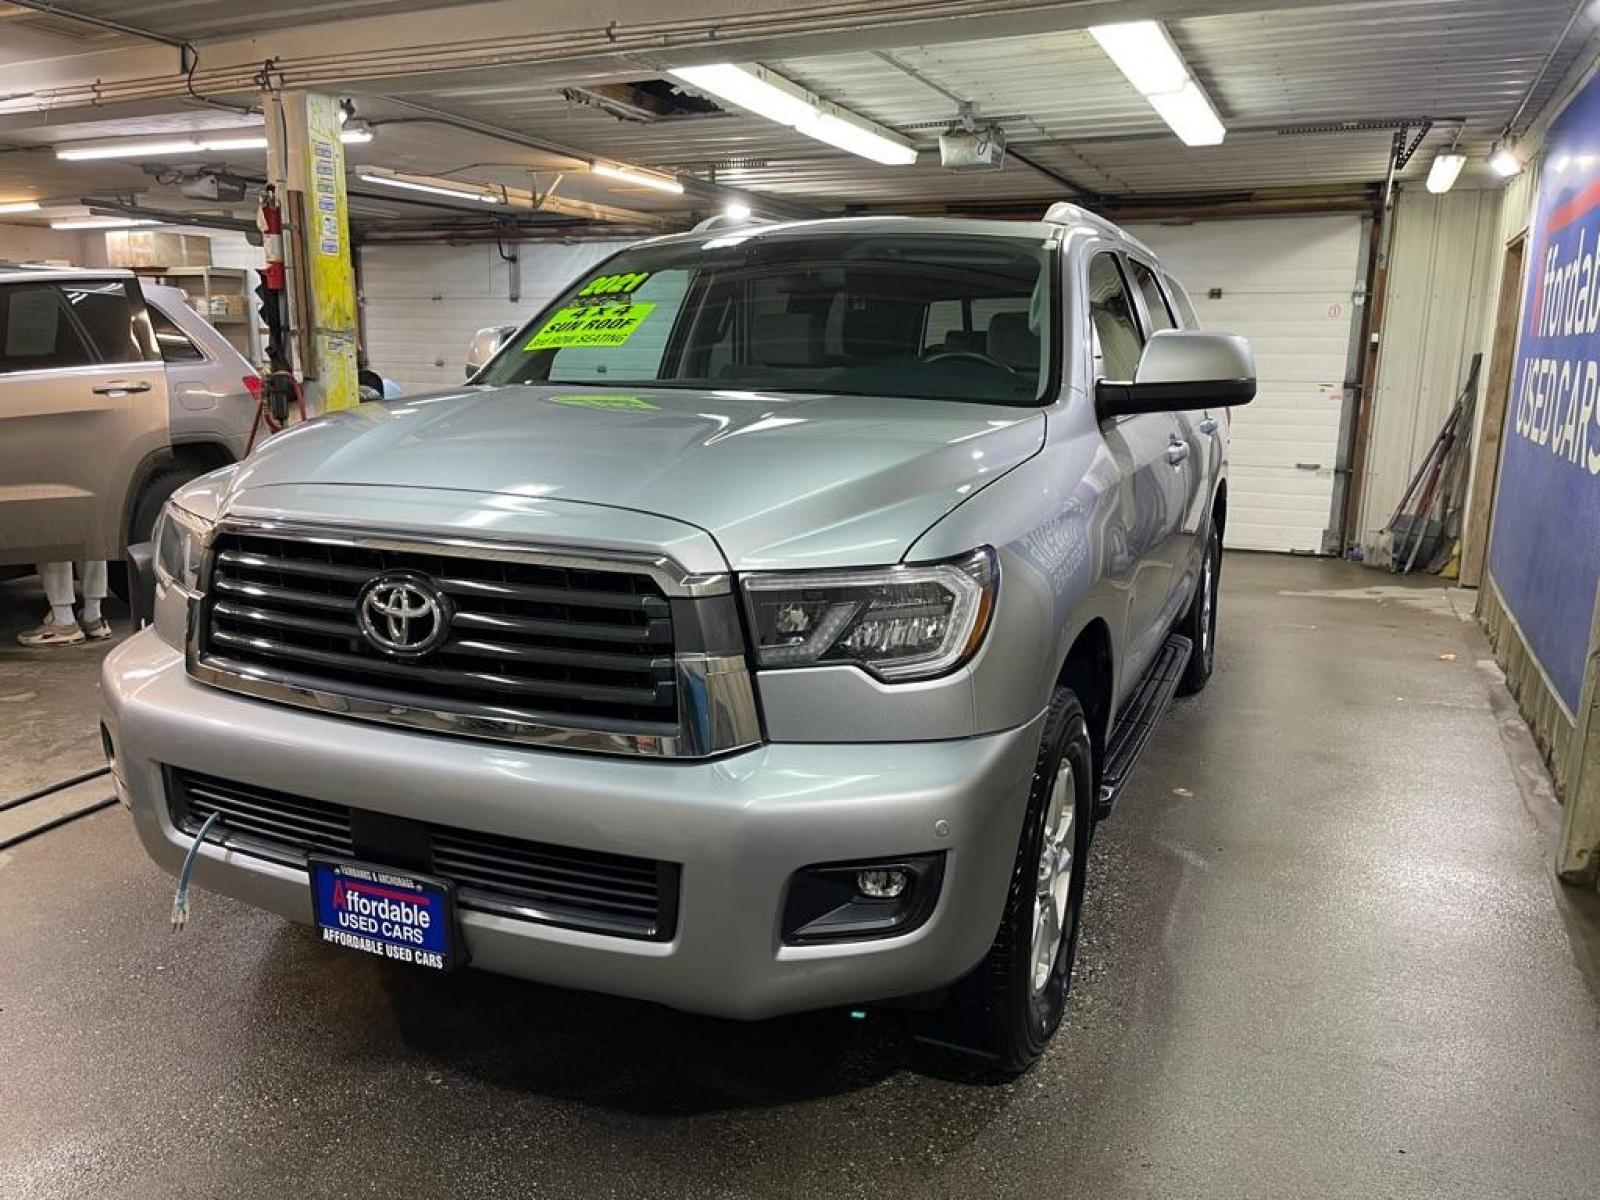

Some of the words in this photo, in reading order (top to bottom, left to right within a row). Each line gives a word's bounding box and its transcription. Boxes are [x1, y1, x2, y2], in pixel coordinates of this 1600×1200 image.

[579, 272, 650, 297] 2021
[544, 320, 581, 334] SUN
[582, 318, 637, 331] ROOF
[576, 333, 628, 343] SEATING
[1516, 357, 1557, 446] USED
[332, 880, 431, 928] Affordable
[338, 912, 379, 934] USED
[382, 922, 425, 944] CARS
[323, 927, 384, 956] AFFORDABLE
[385, 944, 412, 962] USED
[415, 951, 443, 970] CARS
